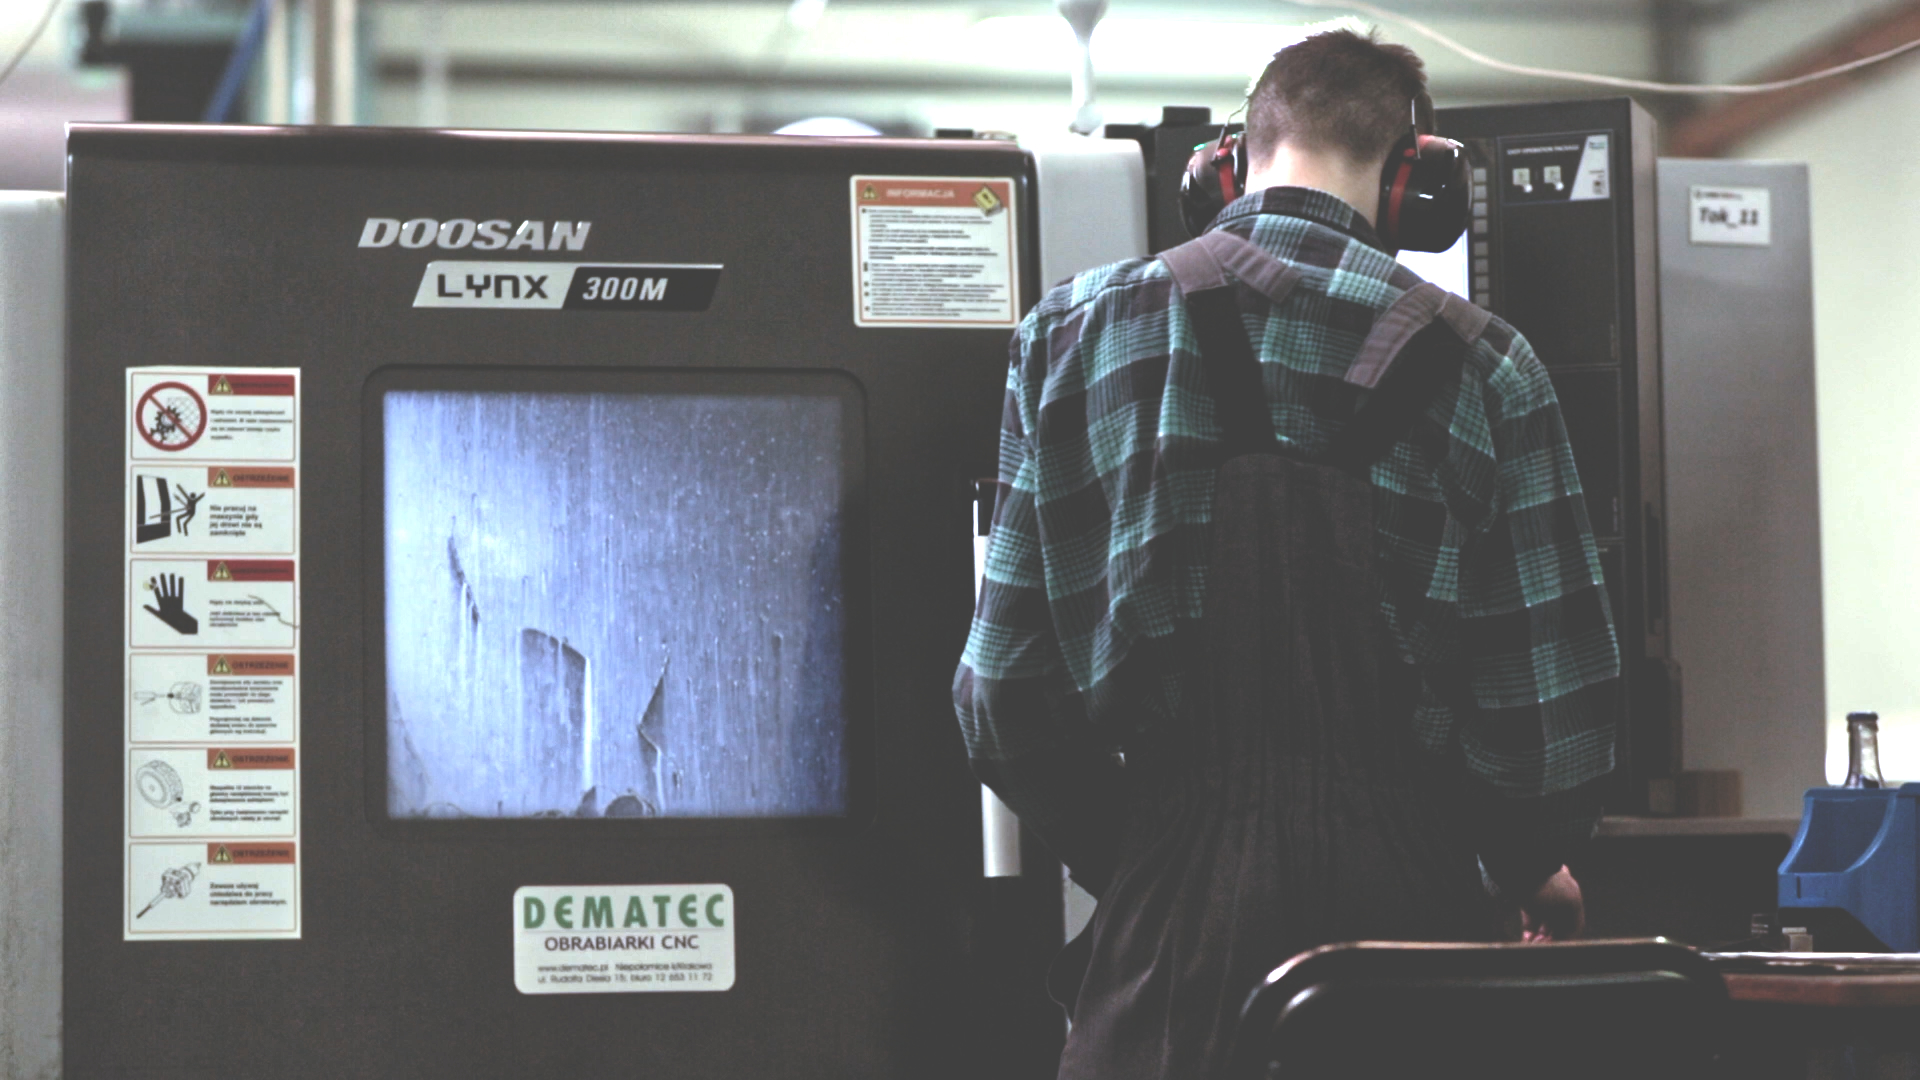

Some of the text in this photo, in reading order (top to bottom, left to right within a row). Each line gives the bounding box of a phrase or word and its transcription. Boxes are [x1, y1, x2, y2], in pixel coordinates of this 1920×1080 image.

[886, 188, 955, 198] INFORMACJA
[357, 217, 592, 251] DOOSAN
[437, 274, 669, 301] LYNX 300M
[223, 505, 247, 513] pracuj
[523, 893, 725, 929] DEMATEC
[544, 935, 700, 951] OBRABIARKI CNC
[537, 963, 609, 973] www.dematec.pl
[551, 974, 583, 983] Rudolfa
[655, 973, 666, 982] 12
[688, 973, 698, 981] 11
[702, 972, 713, 981] 72
